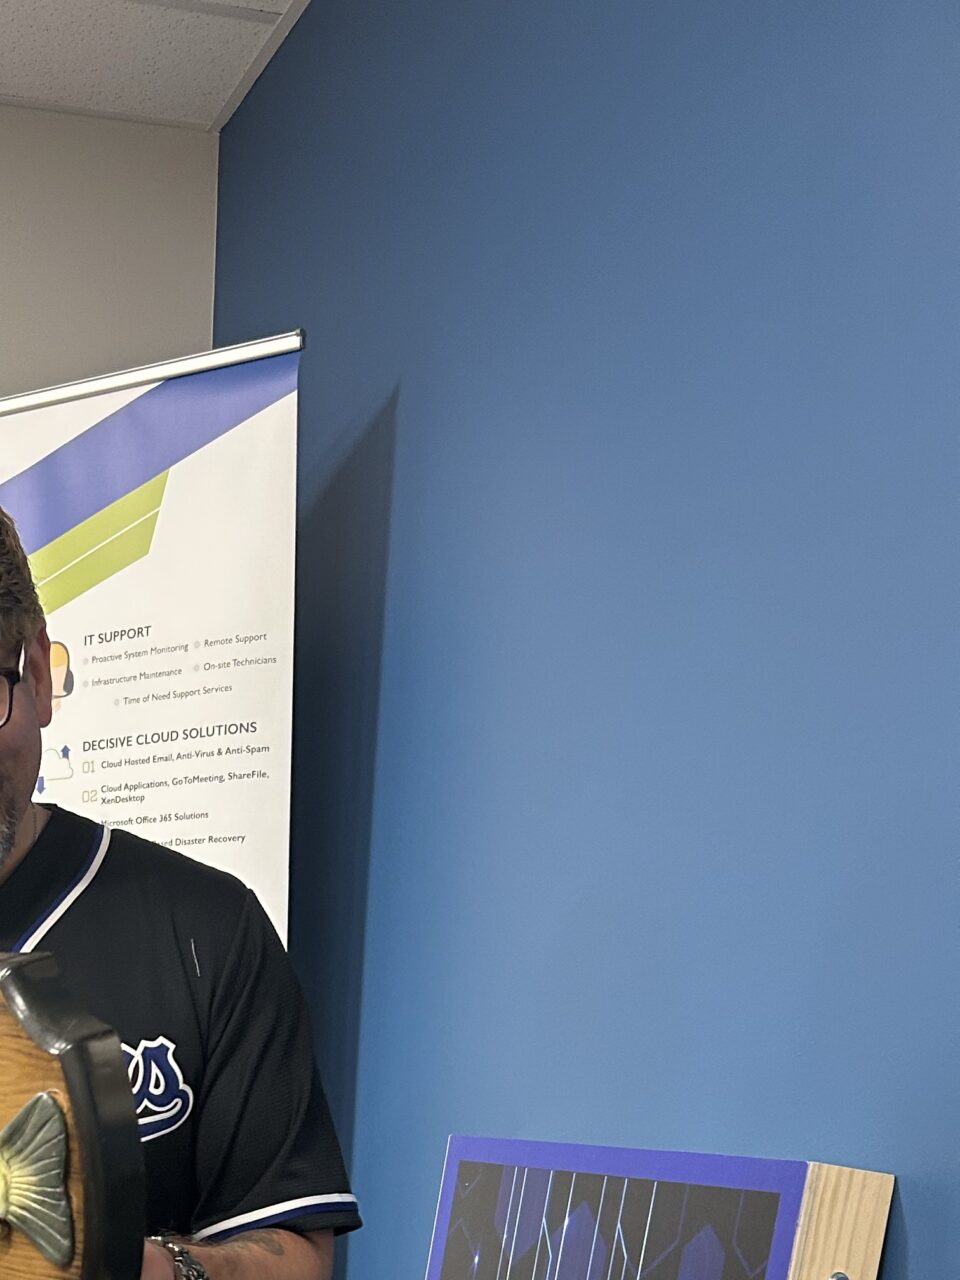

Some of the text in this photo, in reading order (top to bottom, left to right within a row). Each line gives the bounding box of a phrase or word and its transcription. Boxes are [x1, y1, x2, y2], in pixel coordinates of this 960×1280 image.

[84, 626, 152, 646] IT SUPPORT
[204, 633, 267, 647] Remote Support
[91, 643, 189, 664] Proactive System Monitoring
[203, 656, 277, 671] On-site Technicians
[91, 668, 182, 687] Infrastructure Maintenance
[123, 685, 233, 705] Time of Need Support Services
[83, 721, 257, 752] DECISIVE CLOUD SOLUTIONS
[101, 758, 122, 769] Cloud
[124, 756, 151, 767] Hosted
[152, 753, 175, 763] Email,
[176, 749, 215, 761] Anti-Virus
[216, 748, 223, 756] &
[225, 745, 270, 757] Anti-Spam
[101, 783, 122, 793] Cloud
[123, 780, 170, 793] Applications,
[172, 774, 226, 787] GoToMeeting,
[227, 770, 270, 781] ShareFile,
[100, 794, 146, 805] XenDesktop
[136, 815, 157, 825] Office
[159, 814, 172, 823] 365
[174, 811, 209, 821] Solutions
[175, 837, 206, 846] Disaster
[208, 834, 246, 845] Recovery
